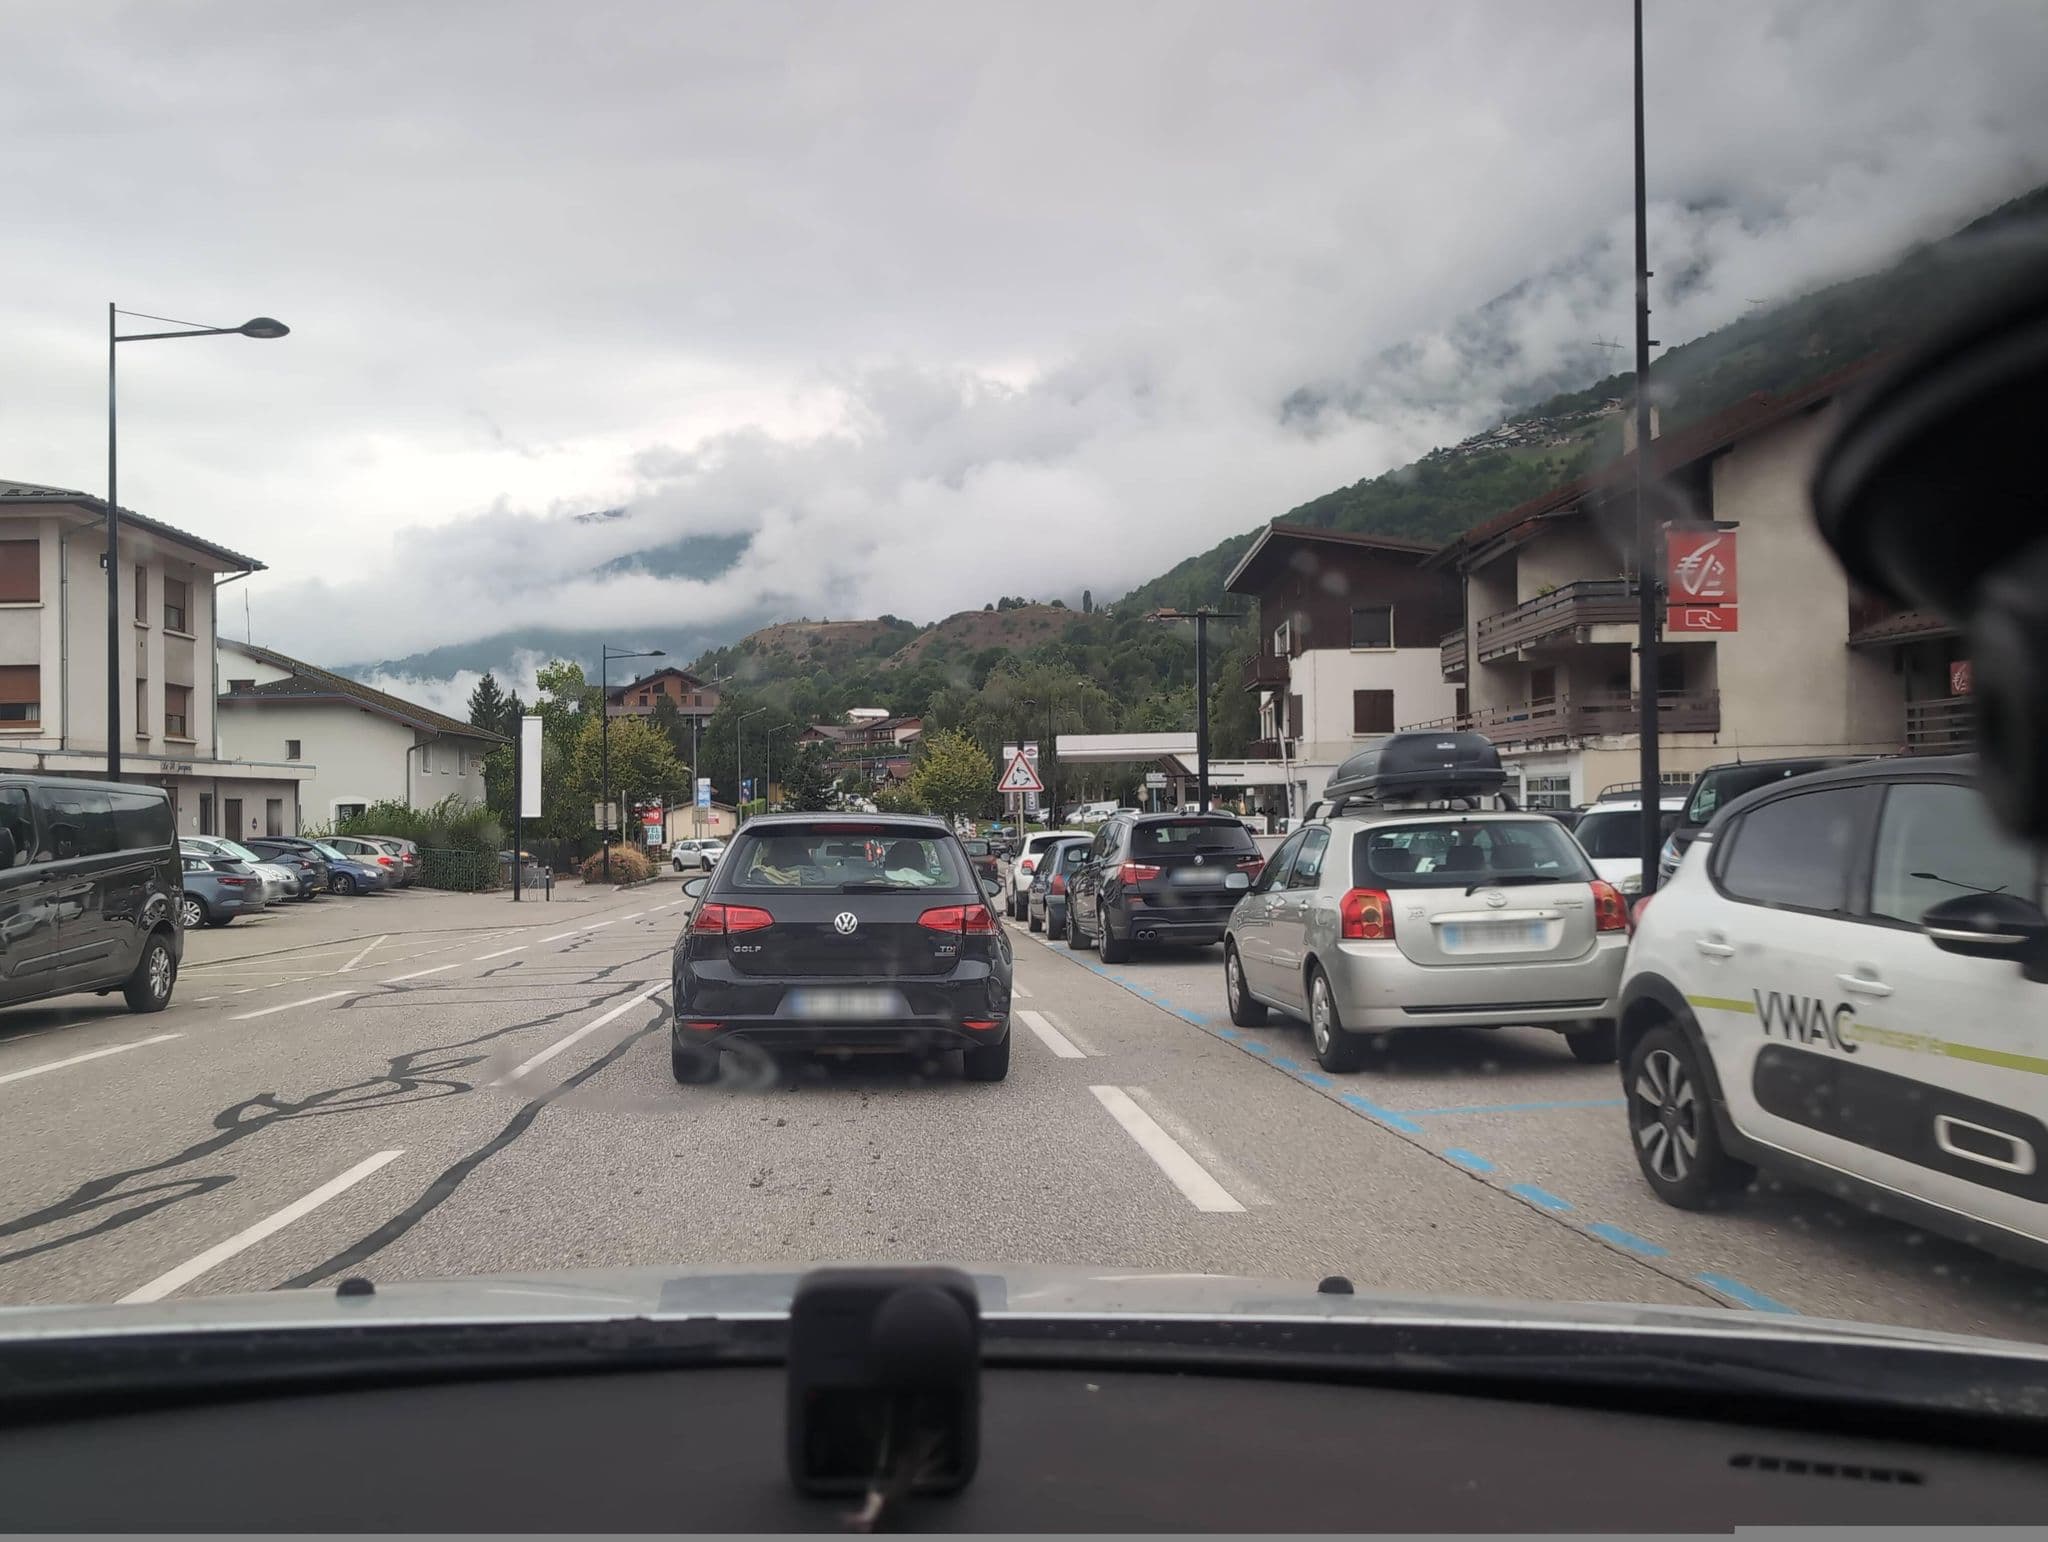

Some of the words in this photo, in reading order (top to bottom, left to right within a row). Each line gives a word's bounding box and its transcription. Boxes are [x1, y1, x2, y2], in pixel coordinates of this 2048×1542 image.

[733, 945, 762, 953] GOLF
[940, 945, 956, 953] TDI
[1753, 988, 1859, 1053] VWAC
